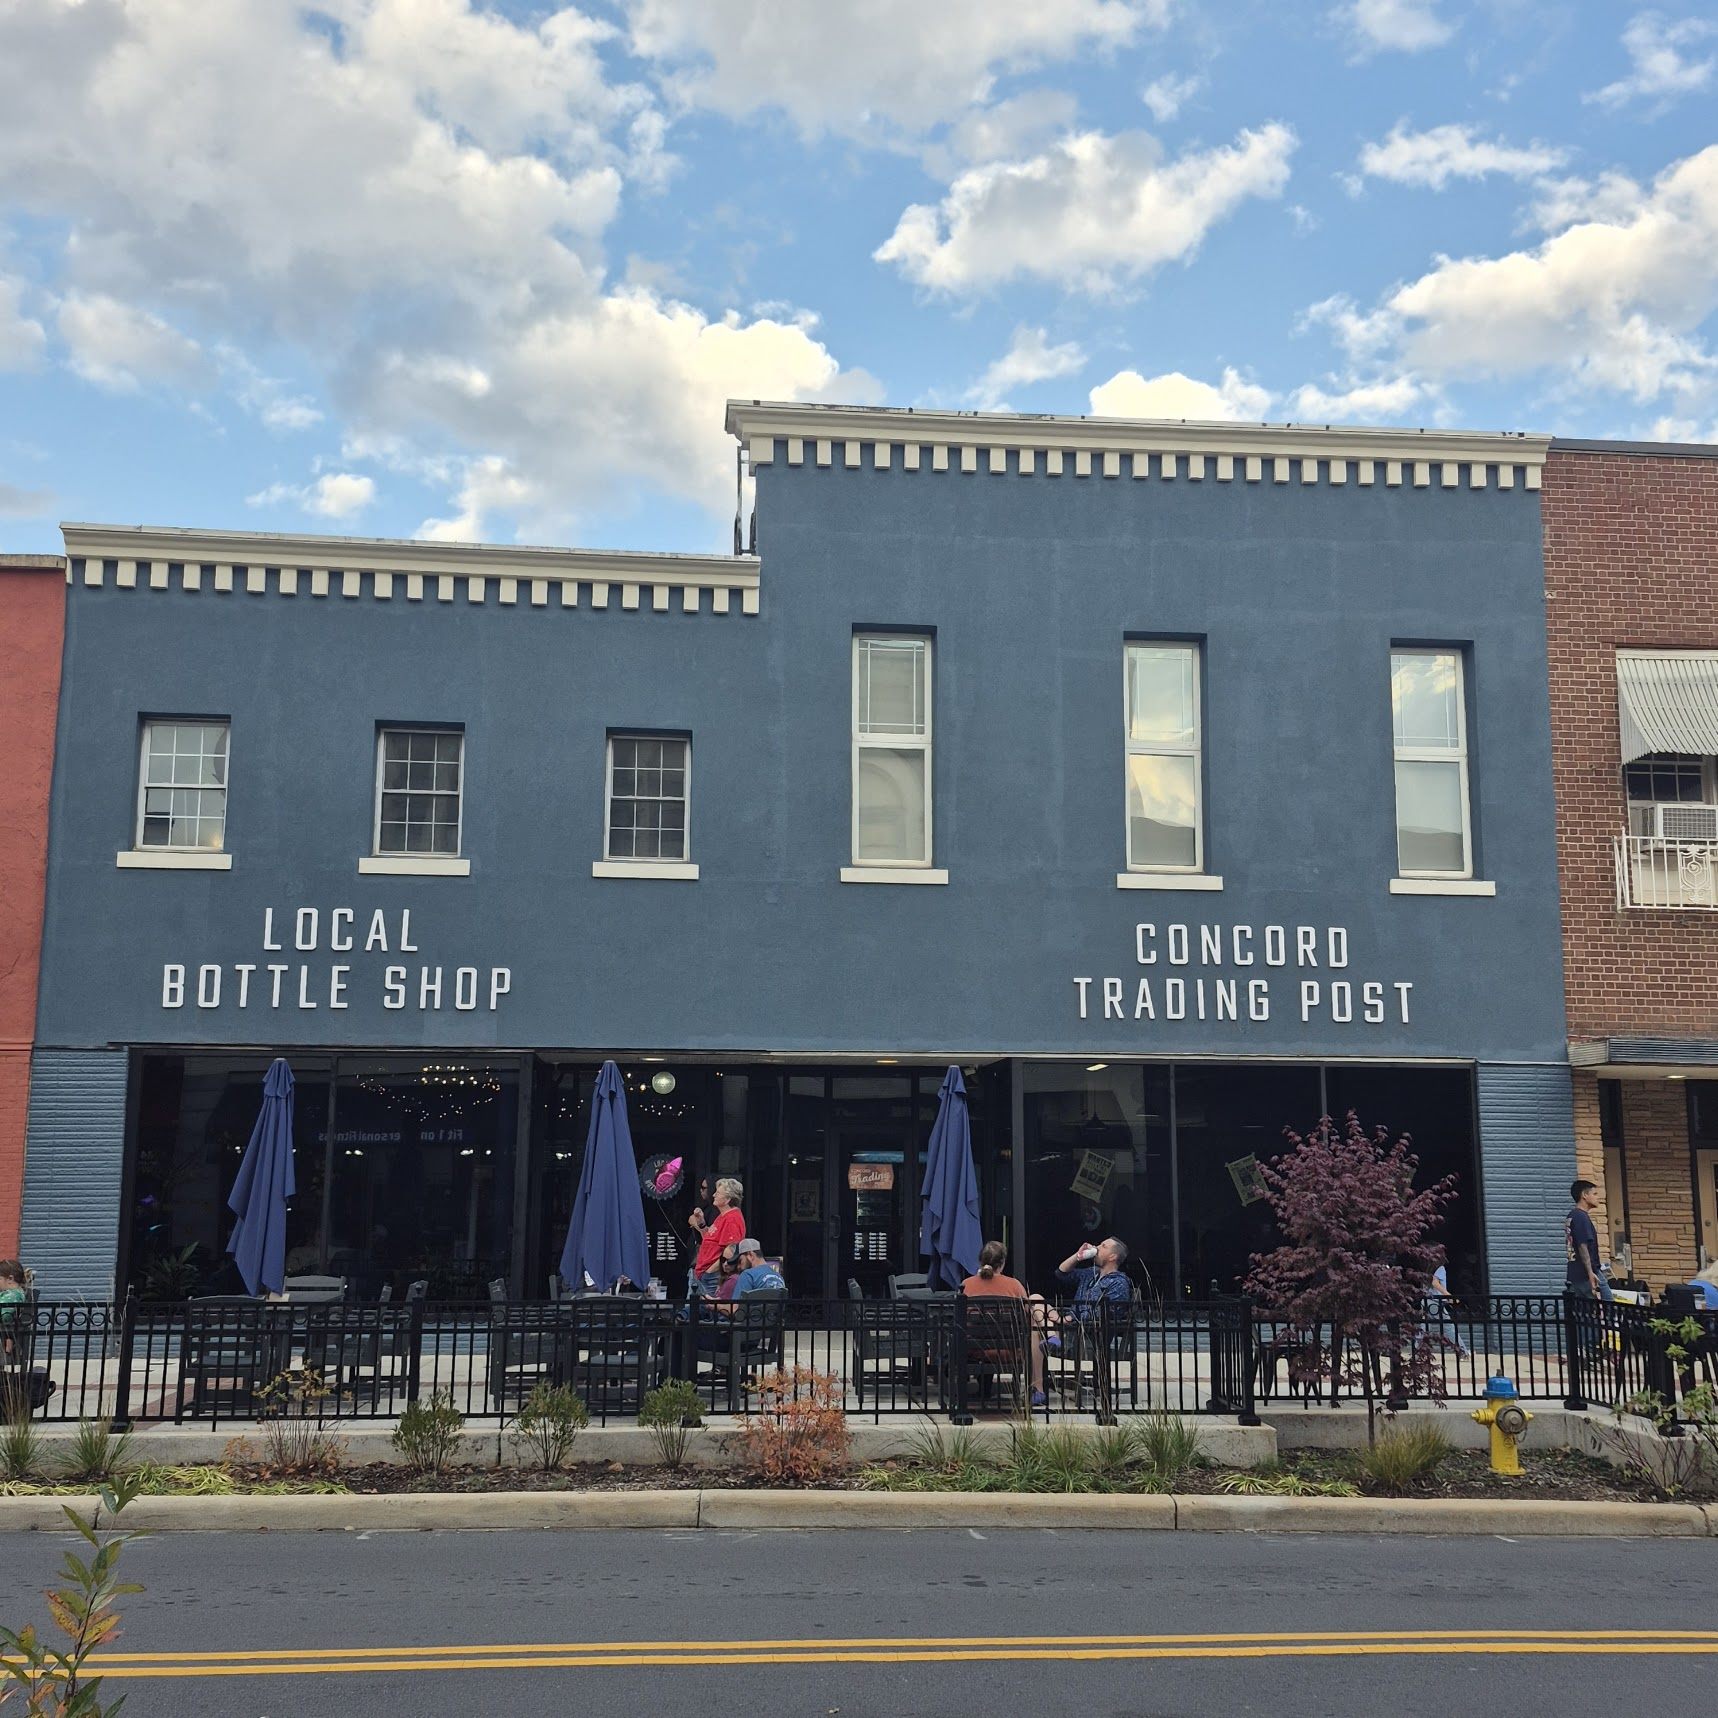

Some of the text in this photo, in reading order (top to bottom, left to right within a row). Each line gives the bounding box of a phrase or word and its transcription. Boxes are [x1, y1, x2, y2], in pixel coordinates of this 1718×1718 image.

[264, 907, 418, 952] LOCAL
[1136, 923, 1348, 968] CONCORD
[162, 964, 511, 1010] BOTTLE SHOP
[1073, 977, 1413, 1023] TRADING POST
